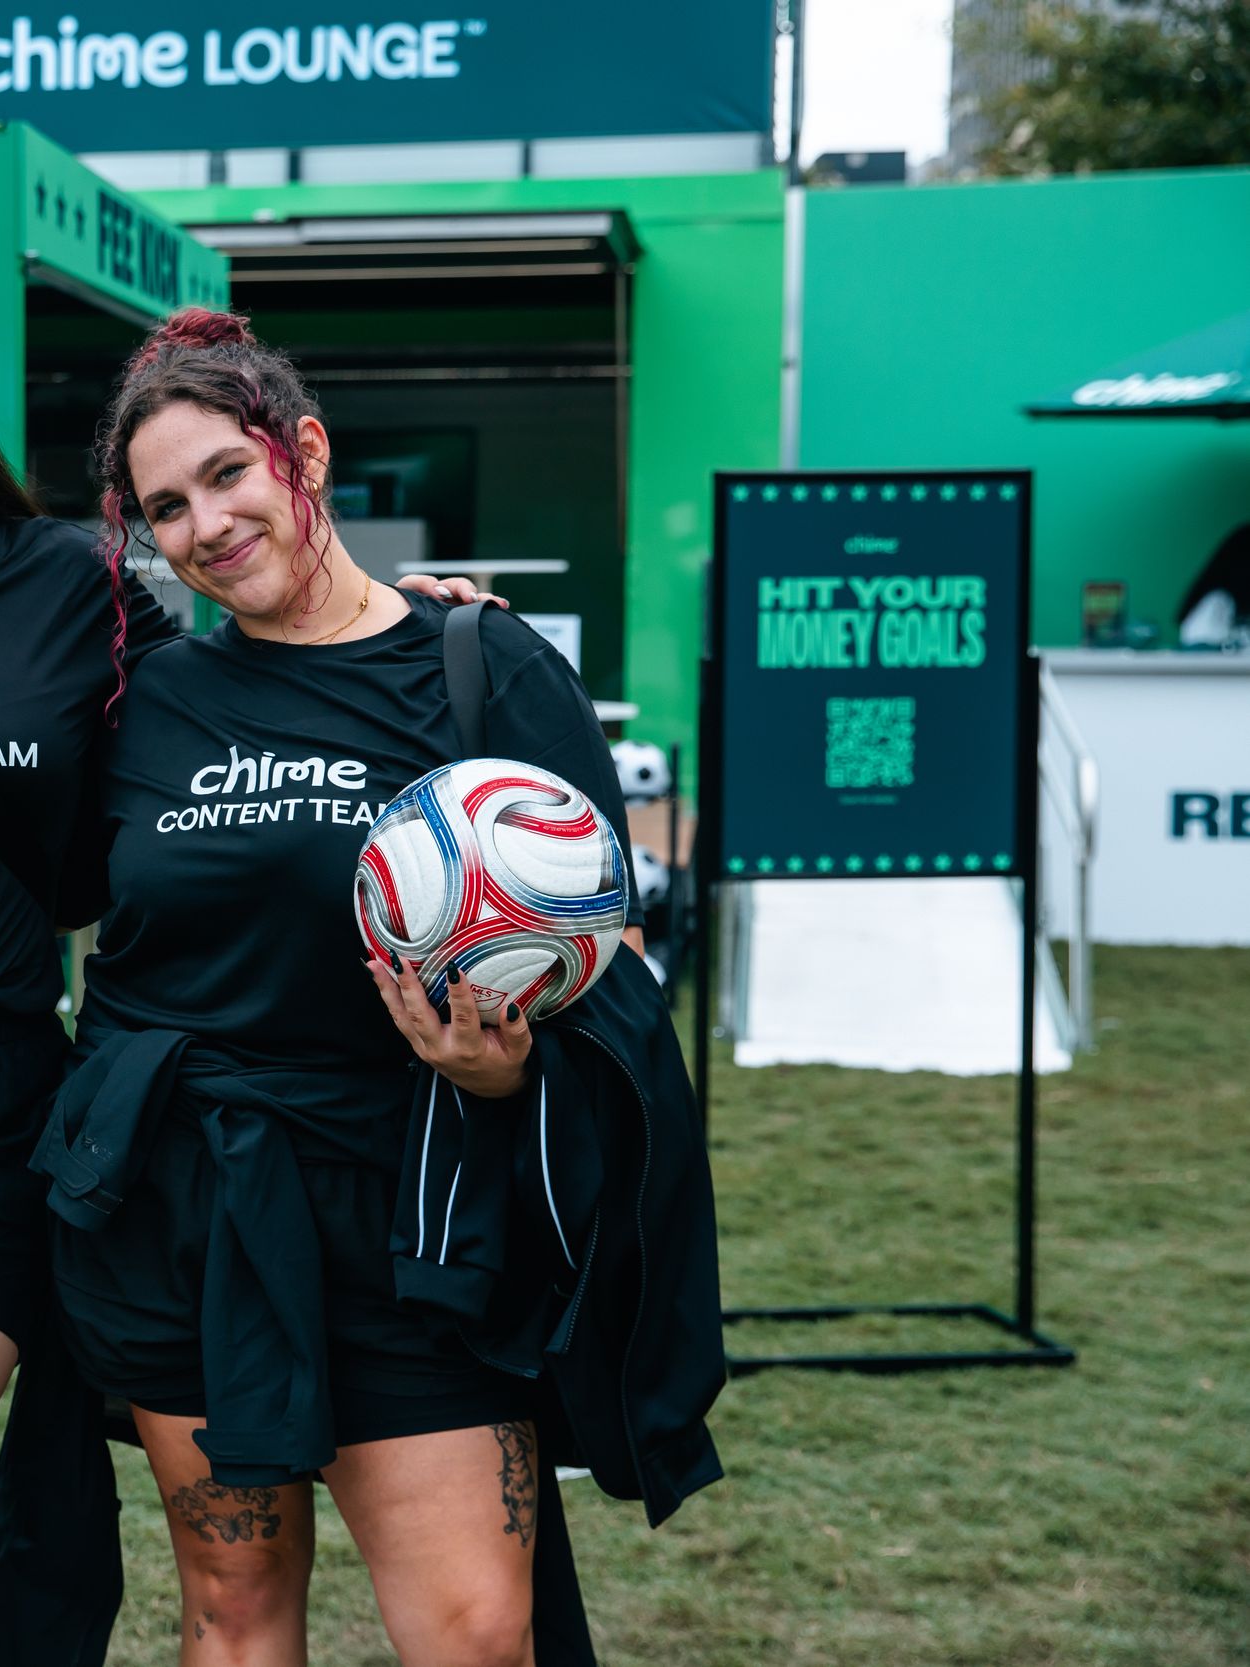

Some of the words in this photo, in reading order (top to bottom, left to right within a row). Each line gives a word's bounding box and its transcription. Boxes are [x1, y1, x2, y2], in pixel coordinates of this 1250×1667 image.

[96, 187, 134, 286] FEE
[758, 576, 845, 610] HIT
[848, 575, 987, 610] YOUR
[757, 610, 876, 669] MONEY
[878, 609, 987, 669] GOALS
[190, 745, 368, 795] chime
[156, 798, 305, 833] CONTENT
[308, 798, 385, 828] TEA
